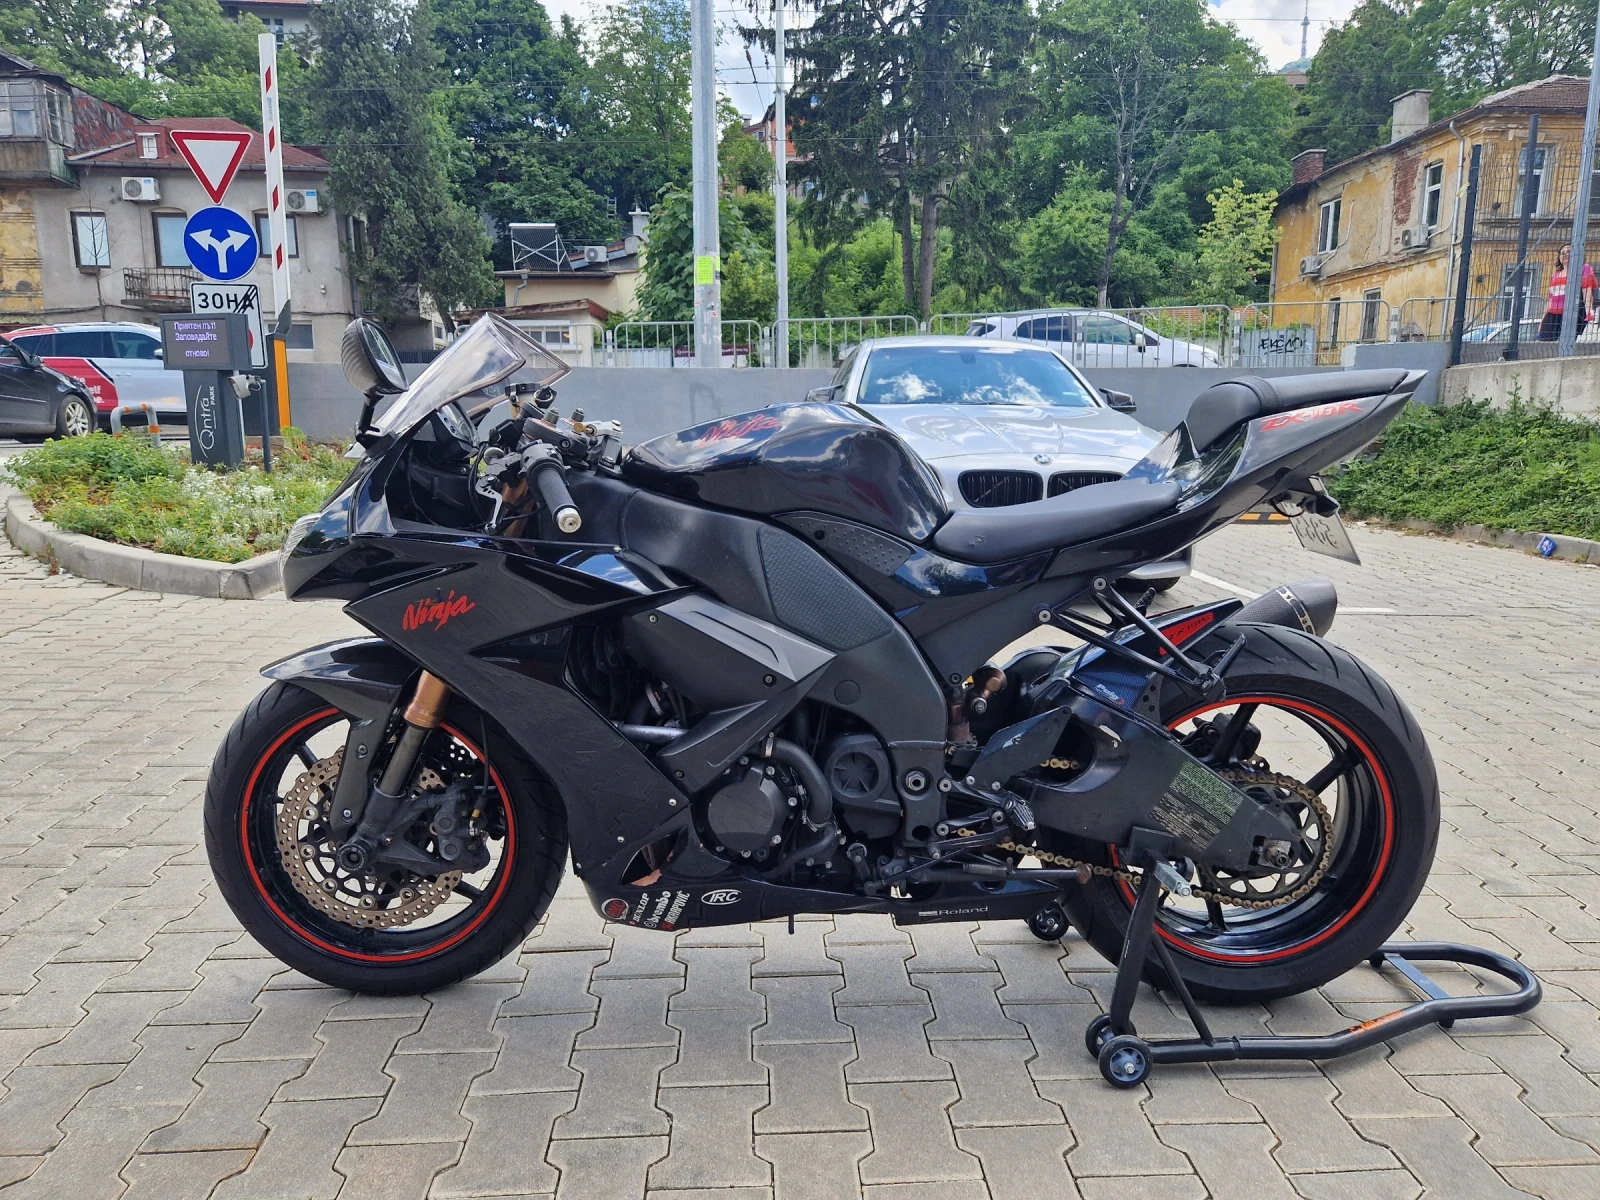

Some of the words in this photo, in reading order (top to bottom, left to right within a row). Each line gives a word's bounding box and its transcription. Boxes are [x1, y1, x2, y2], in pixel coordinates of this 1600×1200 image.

[185, 349, 210, 357] отново!
[402, 589, 476, 631] Ninja
[633, 892, 650, 922] DUNLOP
[651, 890, 672, 924] brembo
[709, 891, 739, 903] IRC
[939, 906, 988, 916] Roland
